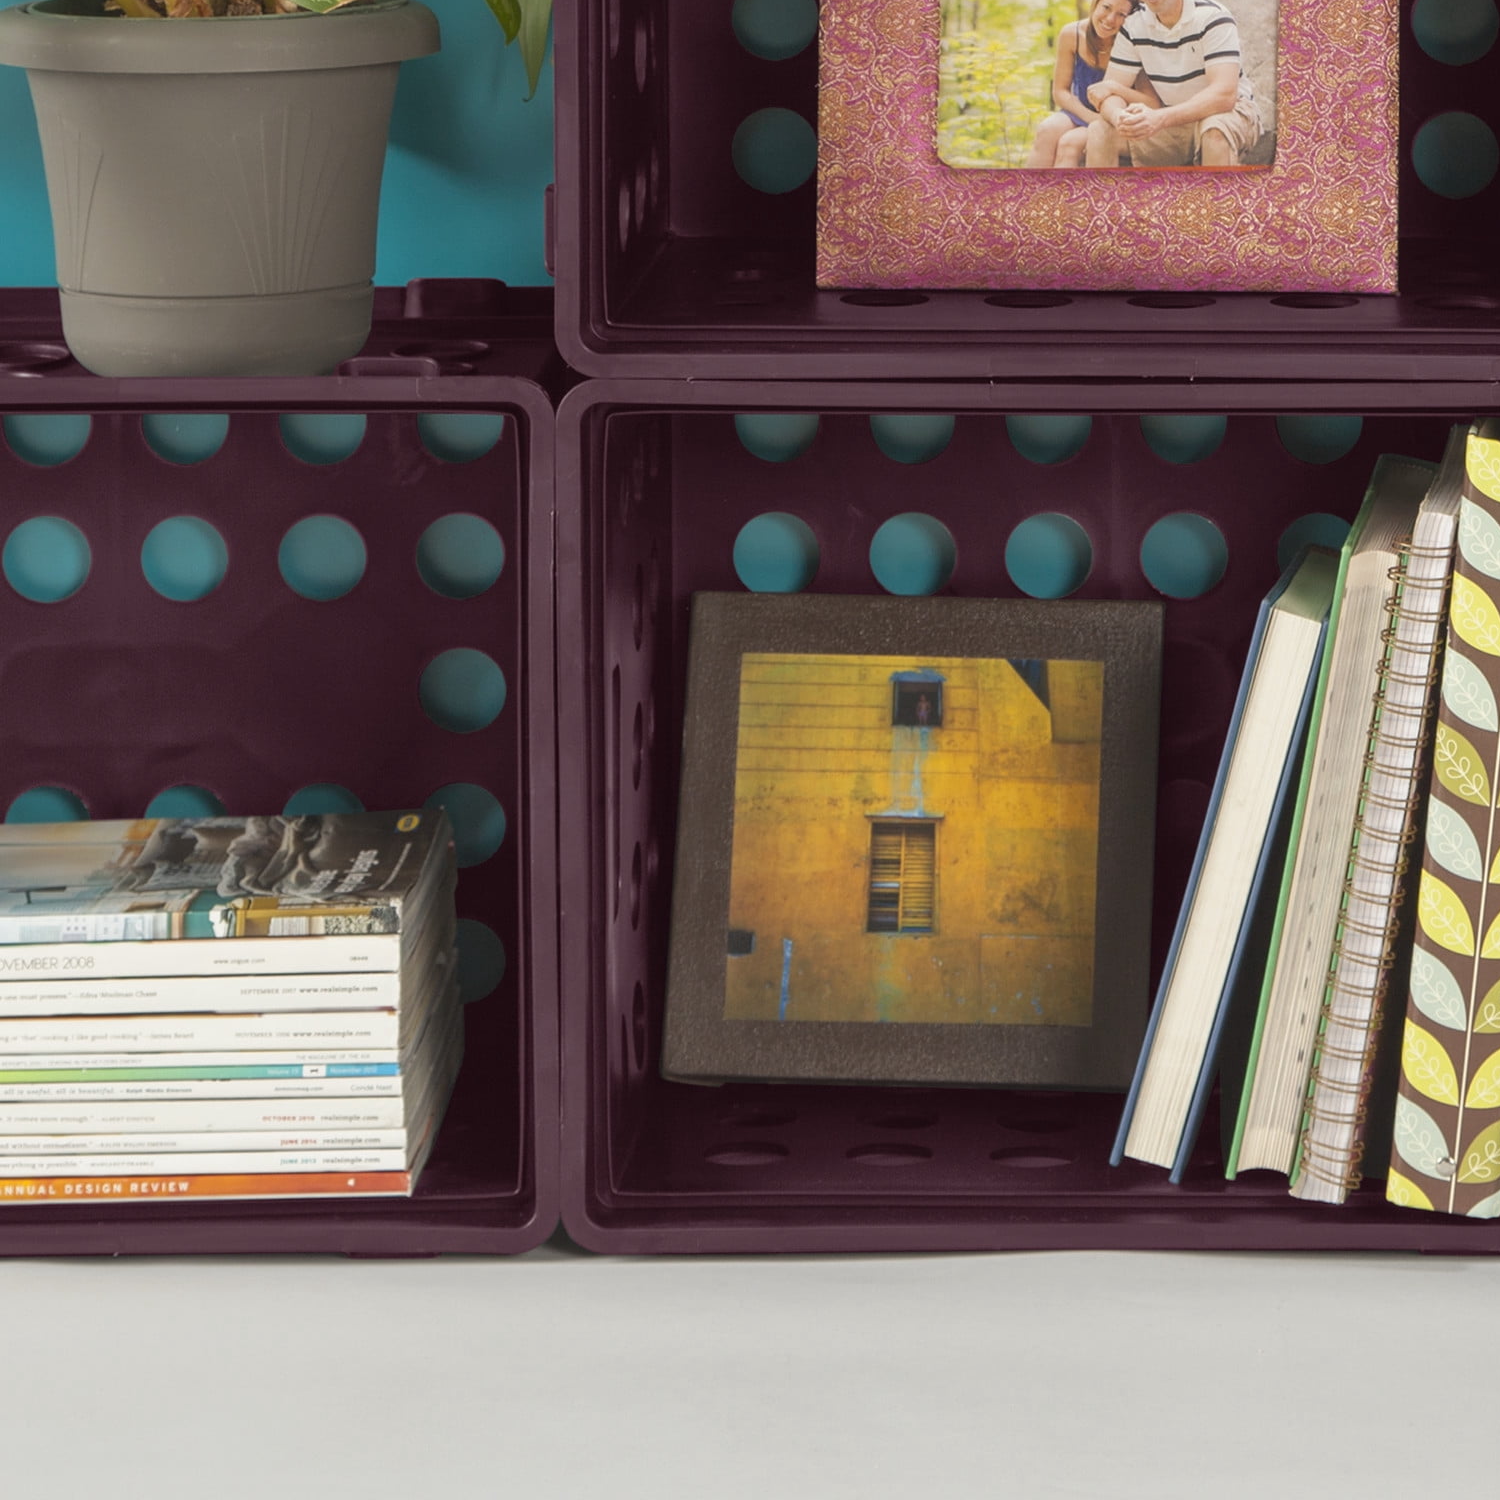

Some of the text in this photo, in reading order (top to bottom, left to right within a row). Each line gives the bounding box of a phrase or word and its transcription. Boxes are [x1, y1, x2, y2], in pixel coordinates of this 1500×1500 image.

[62, 956, 95, 970] 2008
[0, 1181, 190, 1196] NNUAL DESIGN REVIEW
